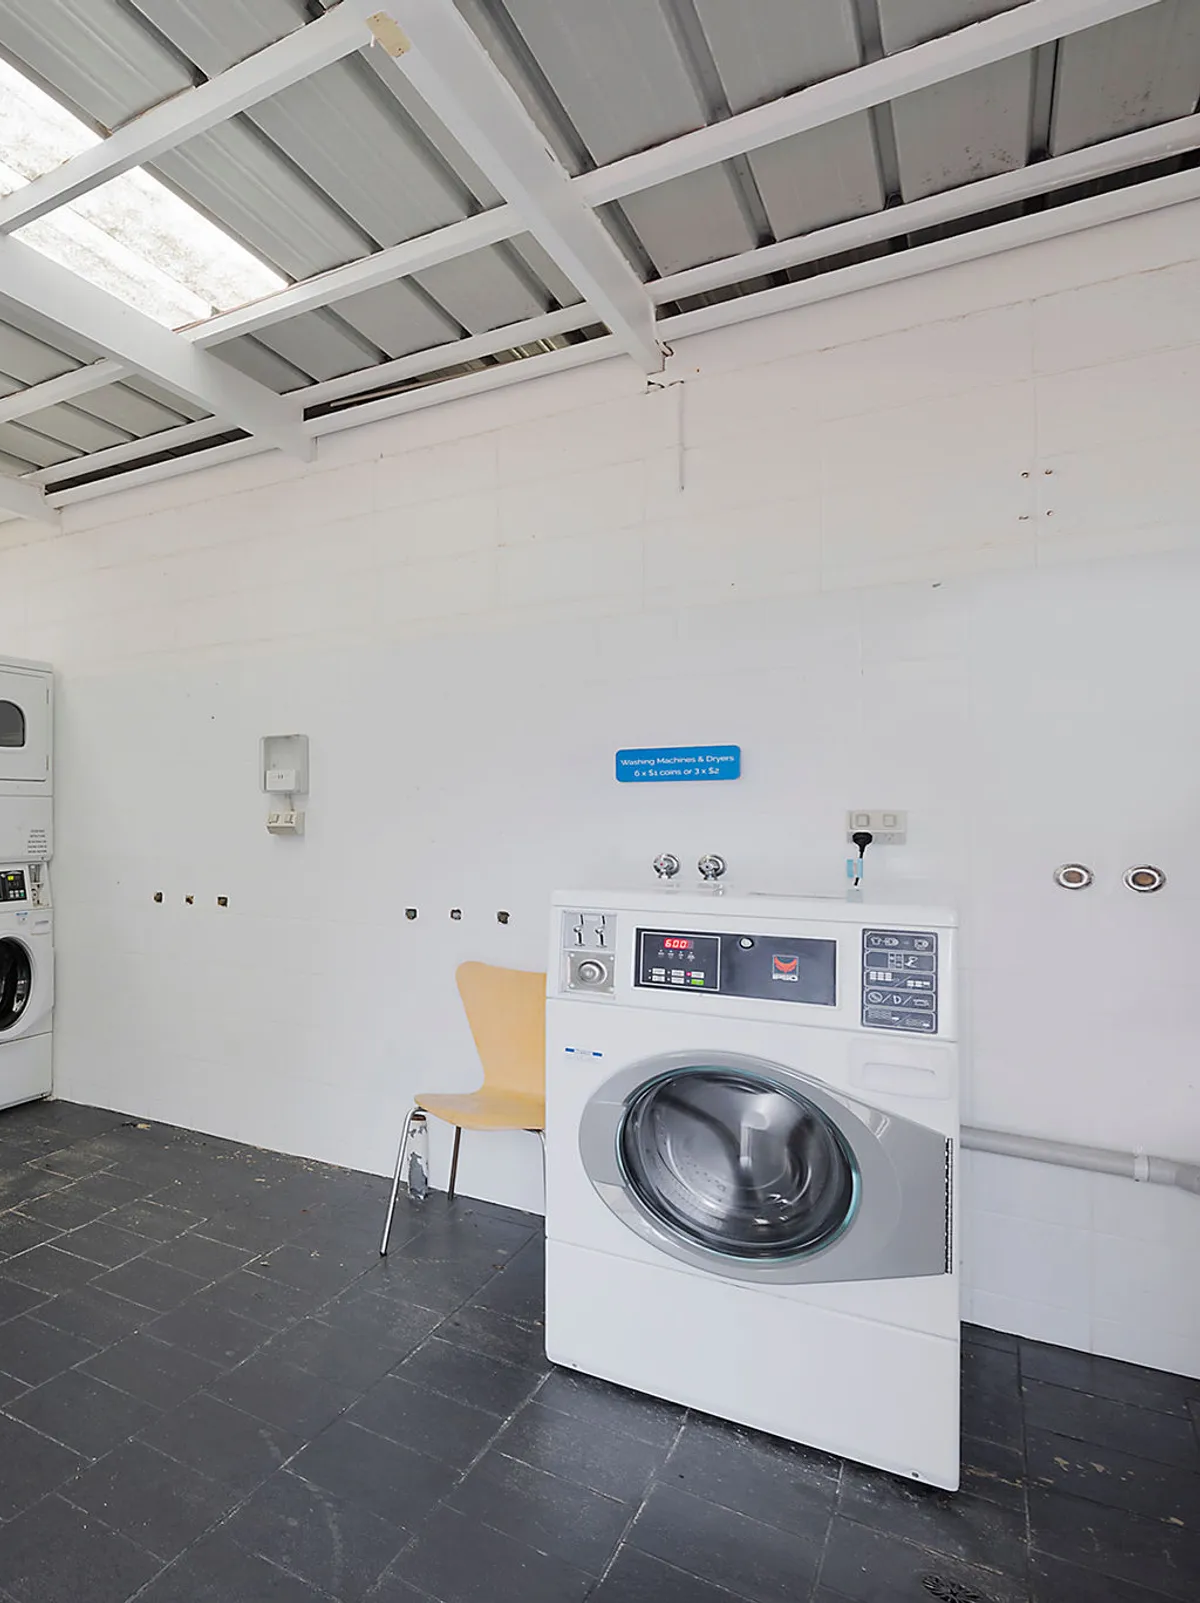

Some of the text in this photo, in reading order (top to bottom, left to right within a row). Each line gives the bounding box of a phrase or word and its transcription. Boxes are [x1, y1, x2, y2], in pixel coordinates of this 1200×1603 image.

[620, 758, 655, 766] Washing
[705, 755, 735, 764] Dryers
[708, 767, 720, 775] $2
